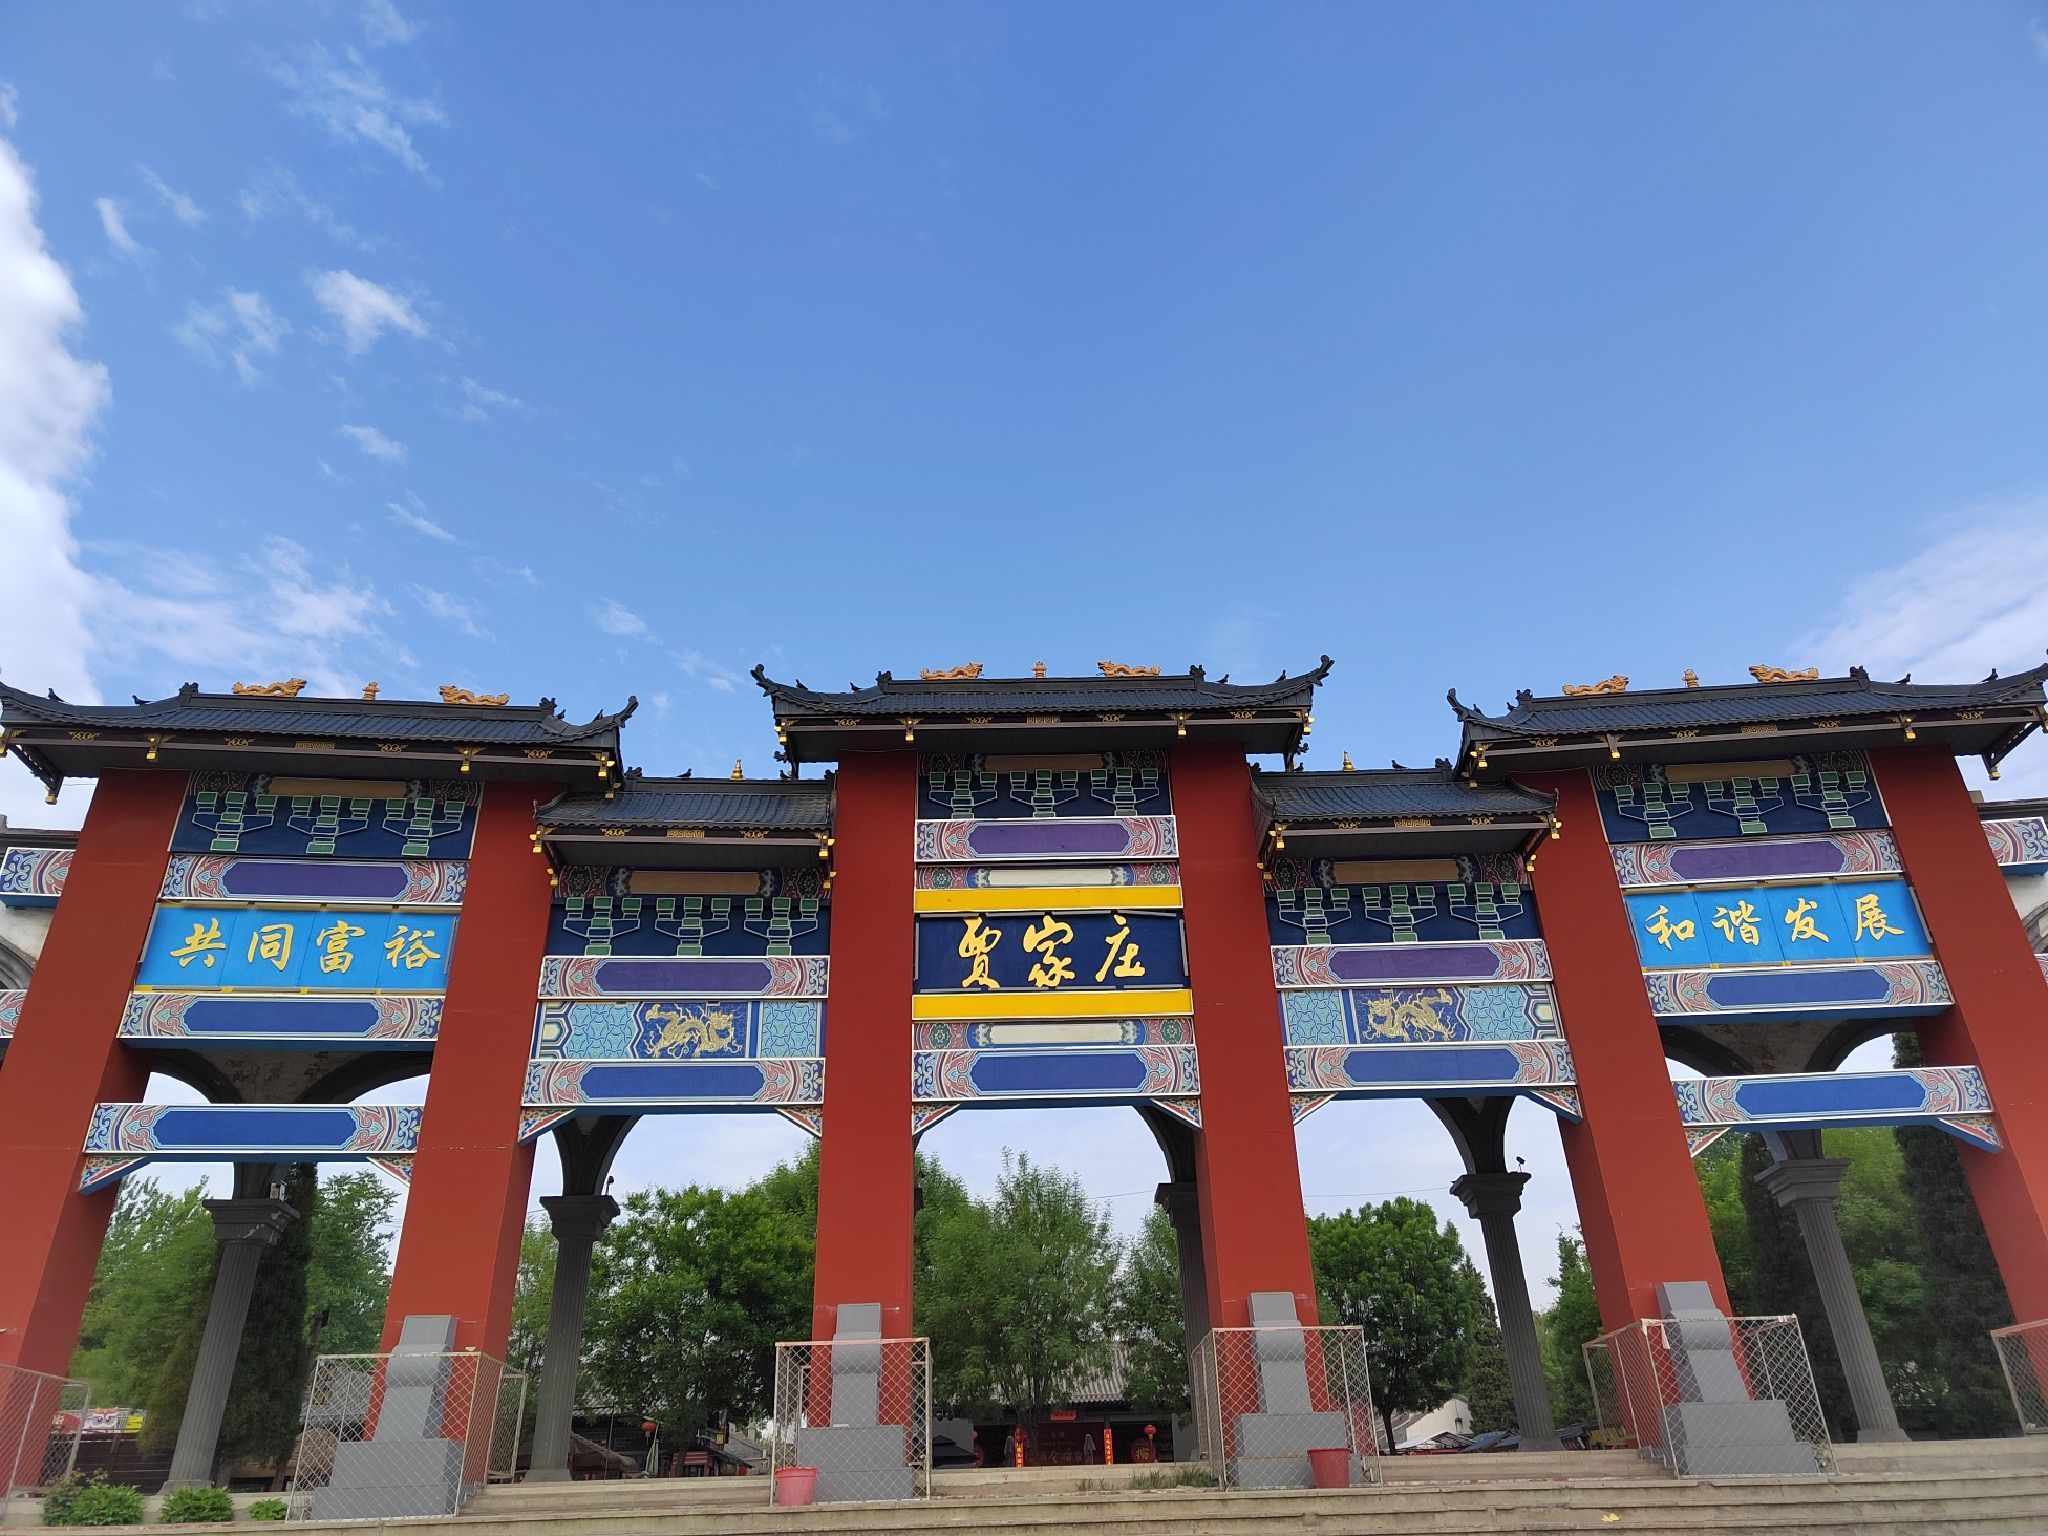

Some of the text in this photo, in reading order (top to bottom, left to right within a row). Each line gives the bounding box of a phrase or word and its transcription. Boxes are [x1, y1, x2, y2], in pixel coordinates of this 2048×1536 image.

[170, 918, 441, 974] 共同富裕
[1645, 893, 1904, 949] 和谐发展
